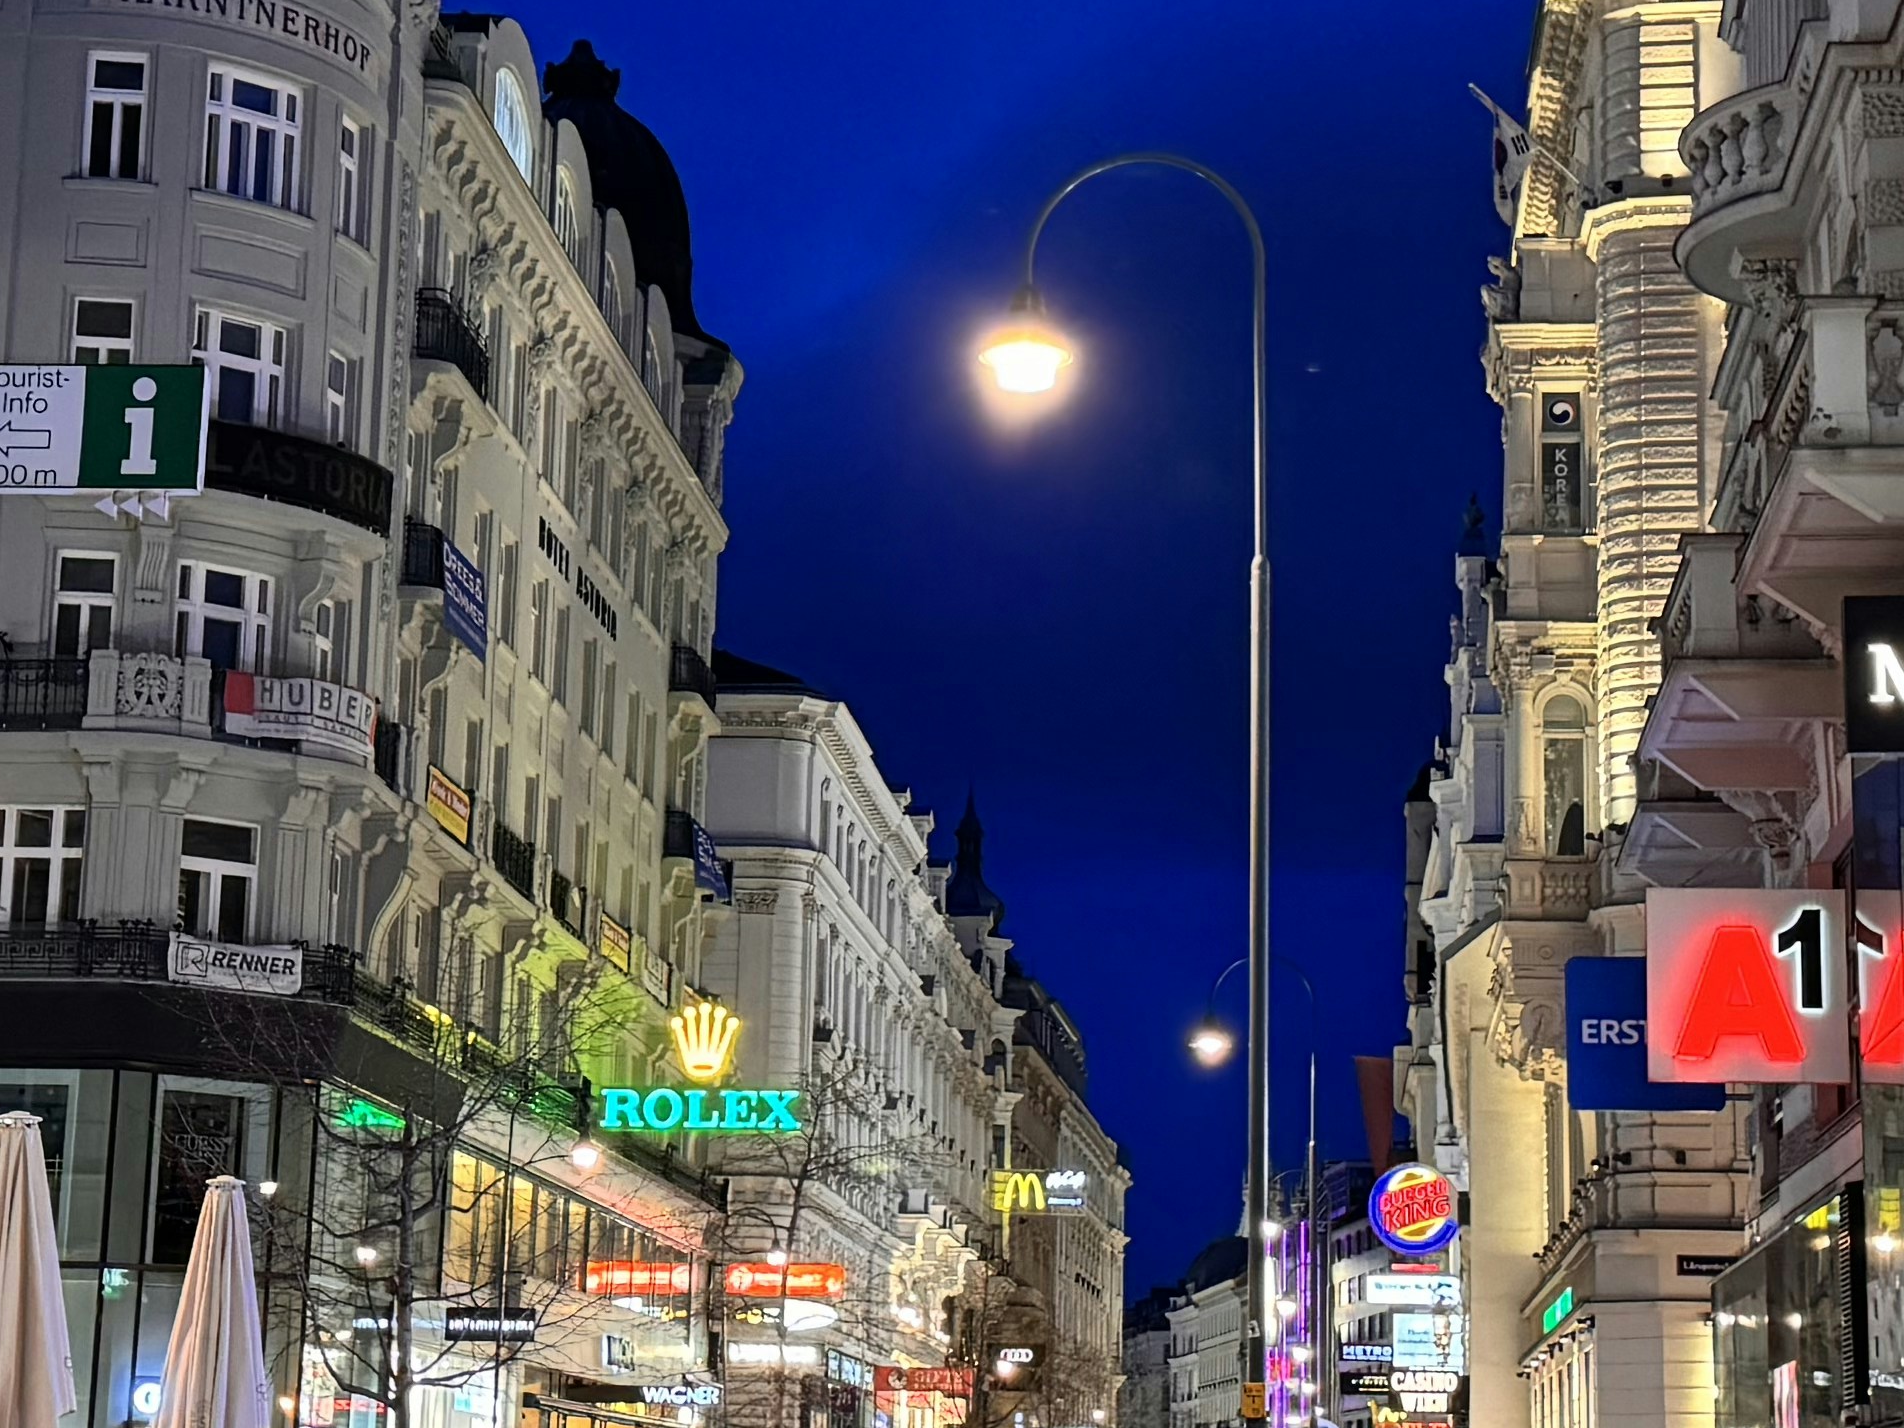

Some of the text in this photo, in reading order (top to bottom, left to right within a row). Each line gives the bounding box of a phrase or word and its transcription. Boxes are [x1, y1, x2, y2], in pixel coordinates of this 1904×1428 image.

[2, 391, 49, 415] Info
[34, 469, 57, 486] m
[1554, 448, 1569, 522] KOREA
[575, 565, 618, 642] ASTORIA
[260, 678, 373, 727] HUBER
[212, 950, 296, 975] RENNER
[601, 1088, 802, 1132] ROLEX
[1383, 1197, 1452, 1232] KING
[641, 1385, 721, 1405] WAGNER
